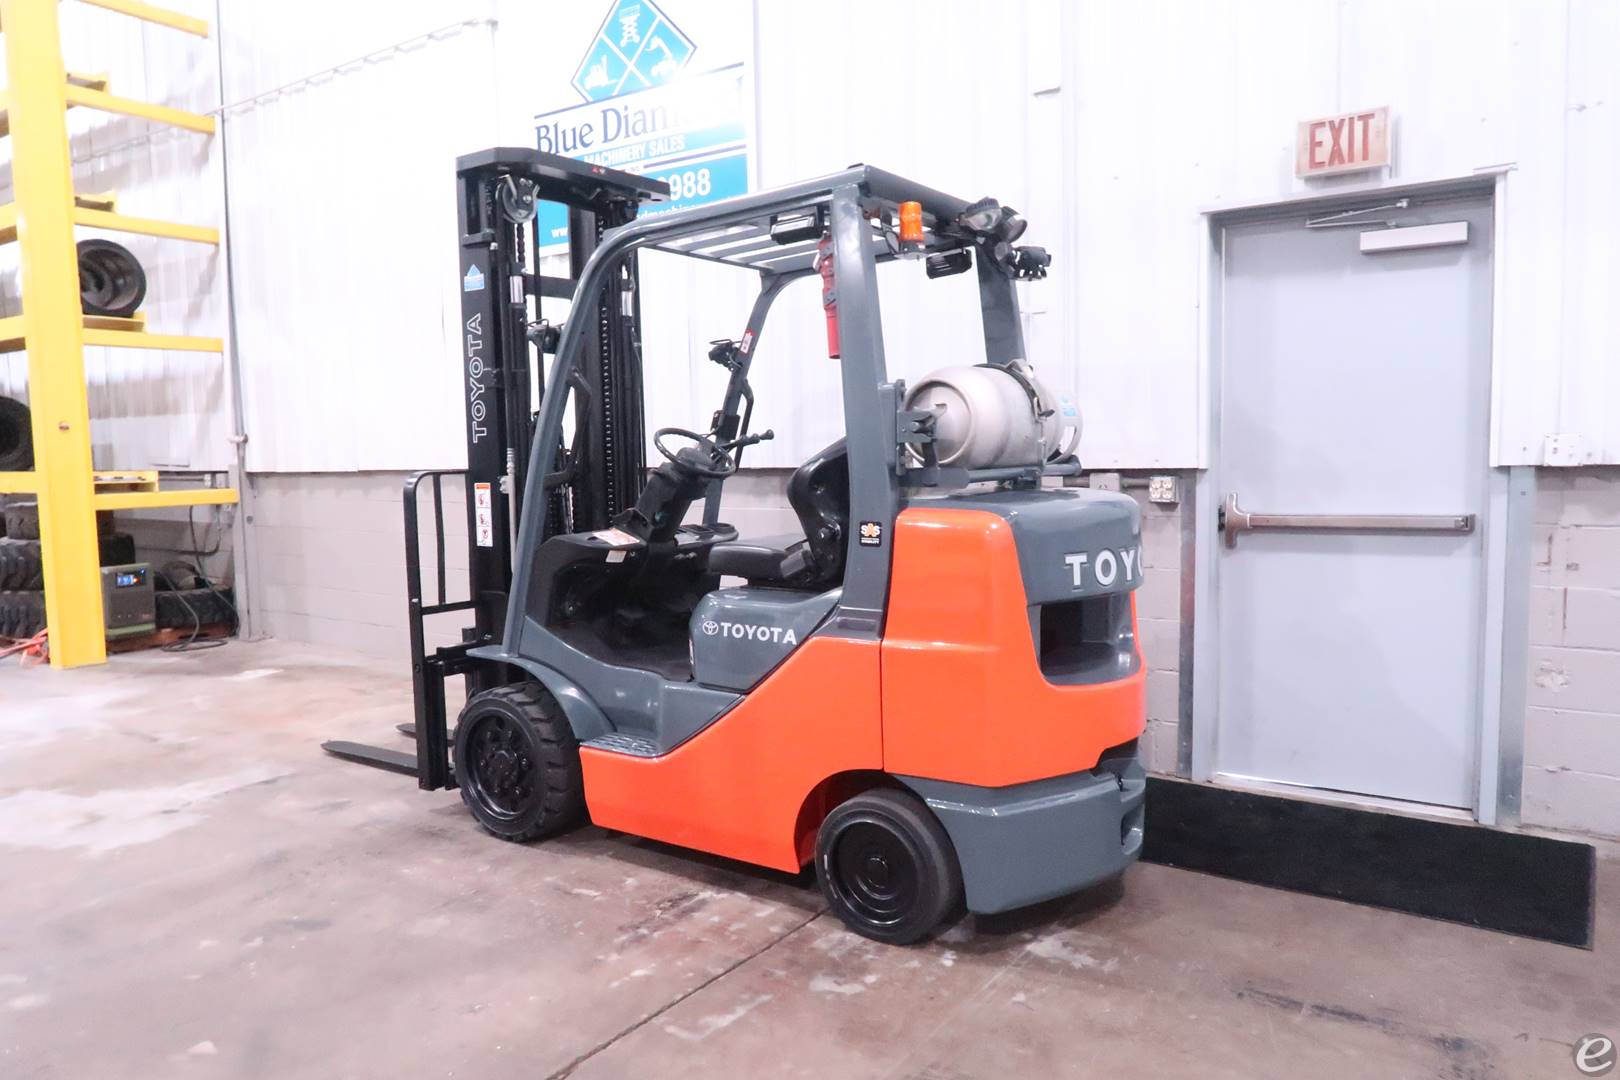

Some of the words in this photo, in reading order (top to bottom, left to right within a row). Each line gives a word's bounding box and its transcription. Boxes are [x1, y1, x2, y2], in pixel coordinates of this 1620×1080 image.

[534, 121, 594, 154] Blue
[583, 140, 646, 167] MACHINERY
[649, 134, 686, 157] SALES
[1308, 112, 1375, 169] EXIT
[657, 168, 711, 201] 988
[467, 312, 488, 444] TOYOTA
[720, 621, 798, 646] TOYOTA
